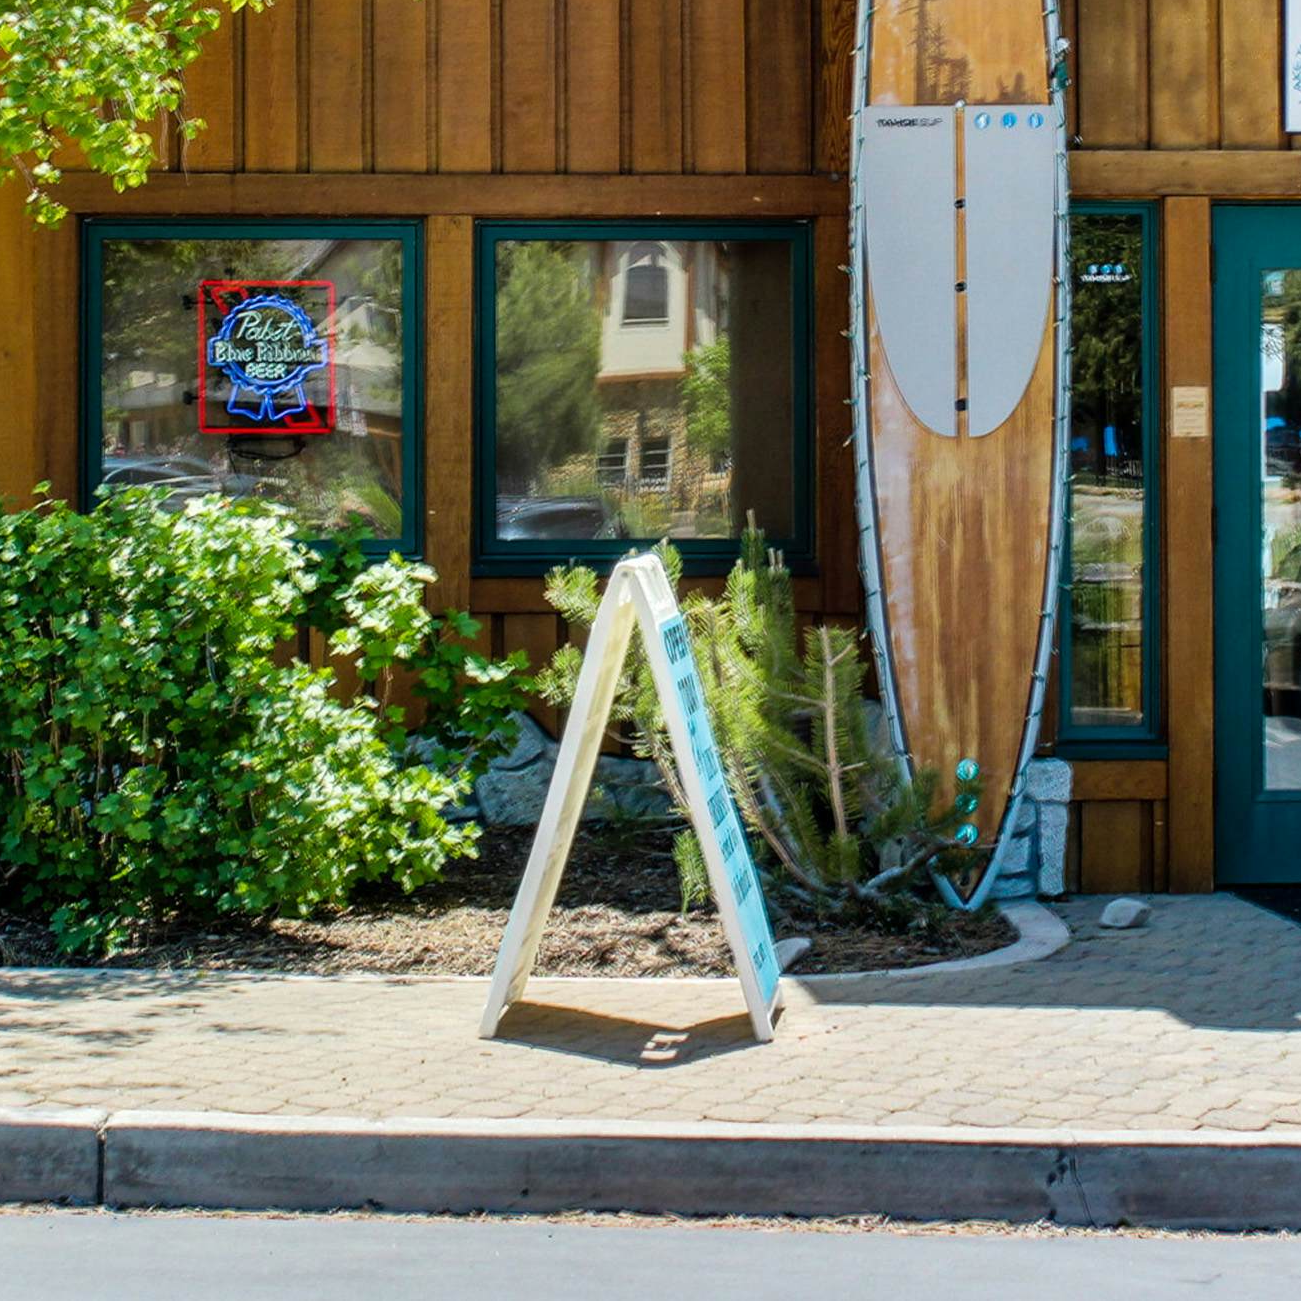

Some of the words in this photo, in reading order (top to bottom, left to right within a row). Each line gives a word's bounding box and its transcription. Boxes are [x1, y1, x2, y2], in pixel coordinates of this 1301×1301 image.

[236, 310, 299, 341] Pabst
[215, 340, 255, 363] Blue
[245, 362, 288, 379] BEER
